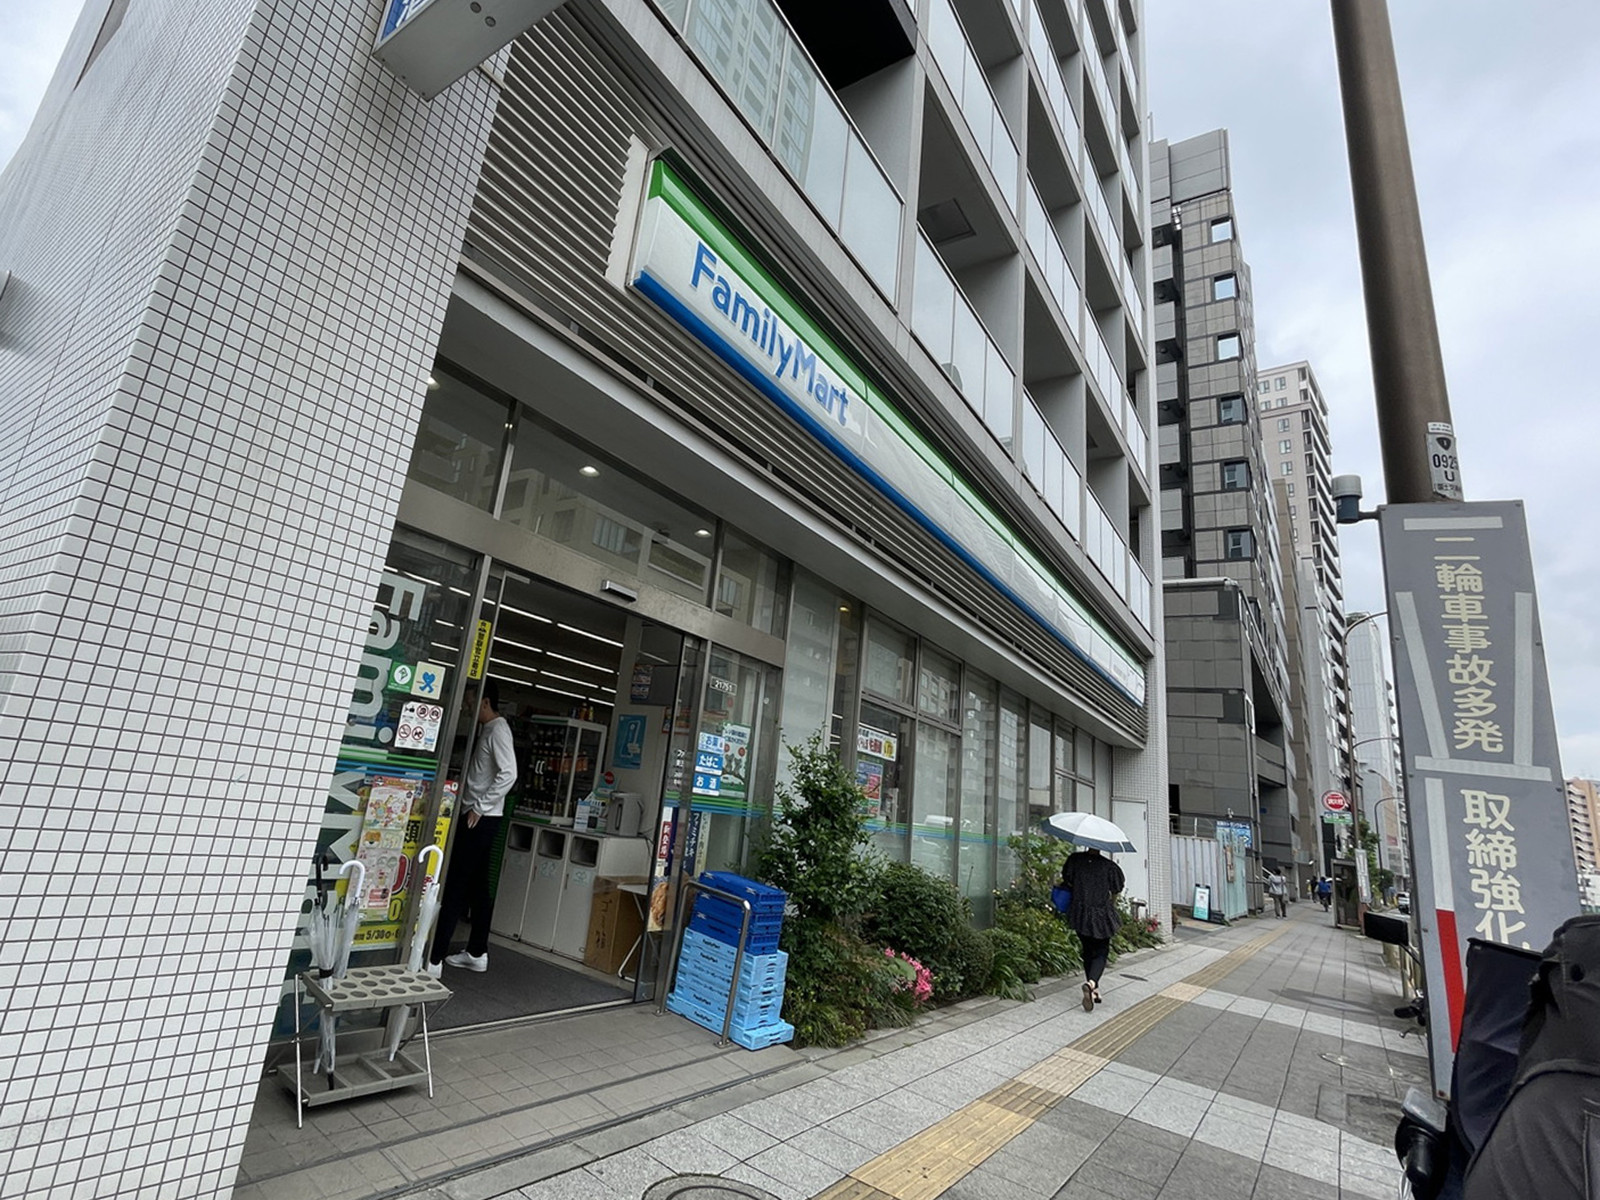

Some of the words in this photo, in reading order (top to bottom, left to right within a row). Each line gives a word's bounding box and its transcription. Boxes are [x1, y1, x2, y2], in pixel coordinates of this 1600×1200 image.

[690, 240, 849, 427] FamilyMart
[714, 680, 734, 692] 21751
[1434, 536, 1504, 753] 二輪車事故多発
[699, 754, 719, 768] たばこ
[1460, 789, 1531, 950] 取締強化
